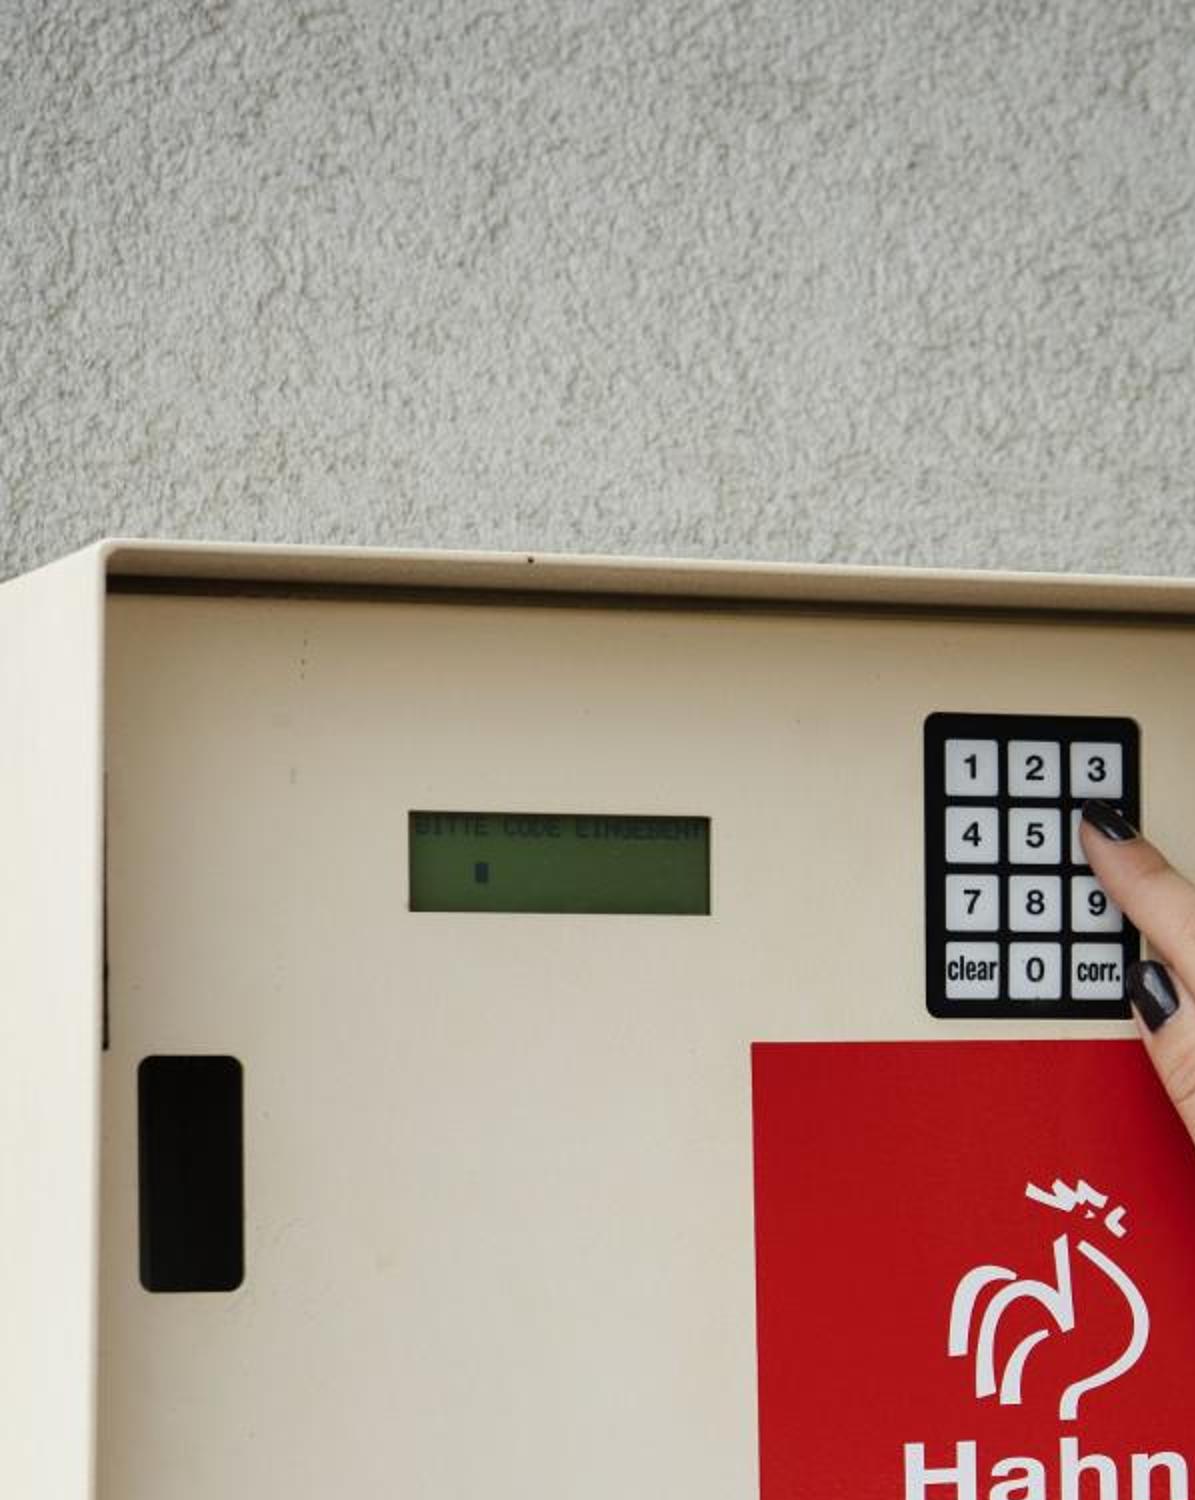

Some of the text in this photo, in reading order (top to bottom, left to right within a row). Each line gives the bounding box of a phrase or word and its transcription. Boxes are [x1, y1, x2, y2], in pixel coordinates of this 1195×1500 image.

[963, 754, 1106, 782] 1 2 3
[962, 822, 1044, 848] 4 5
[964, 890, 1106, 916] 7 8 9
[948, 956, 1120, 982] clear 0 corr.
